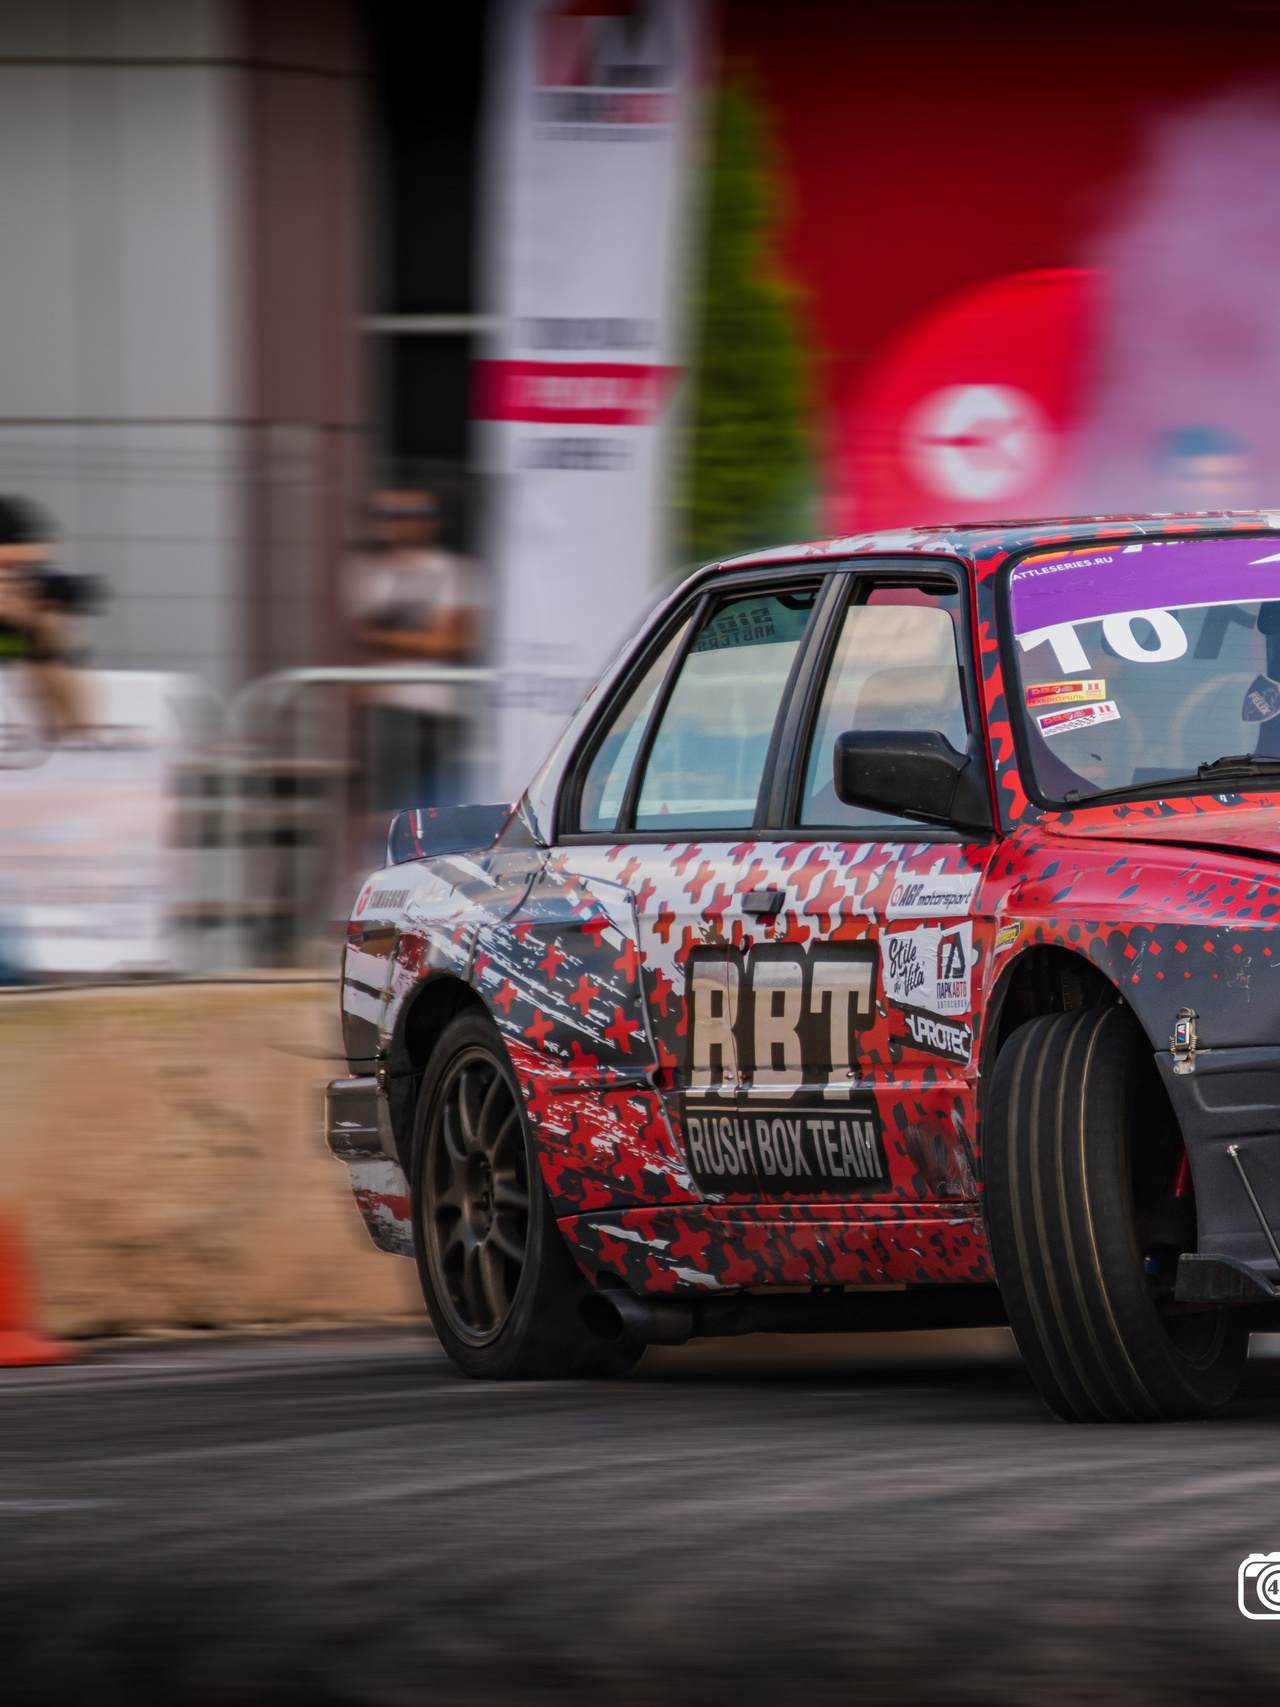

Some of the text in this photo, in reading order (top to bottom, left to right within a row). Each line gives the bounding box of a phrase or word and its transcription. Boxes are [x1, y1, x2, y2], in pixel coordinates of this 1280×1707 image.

[1019, 609, 1188, 674] 10
[916, 888, 973, 910] motorsport
[889, 938, 917, 978] Stile
[685, 961, 873, 1100] RBT
[687, 1117, 883, 1178] RUSH BOX TEAM
